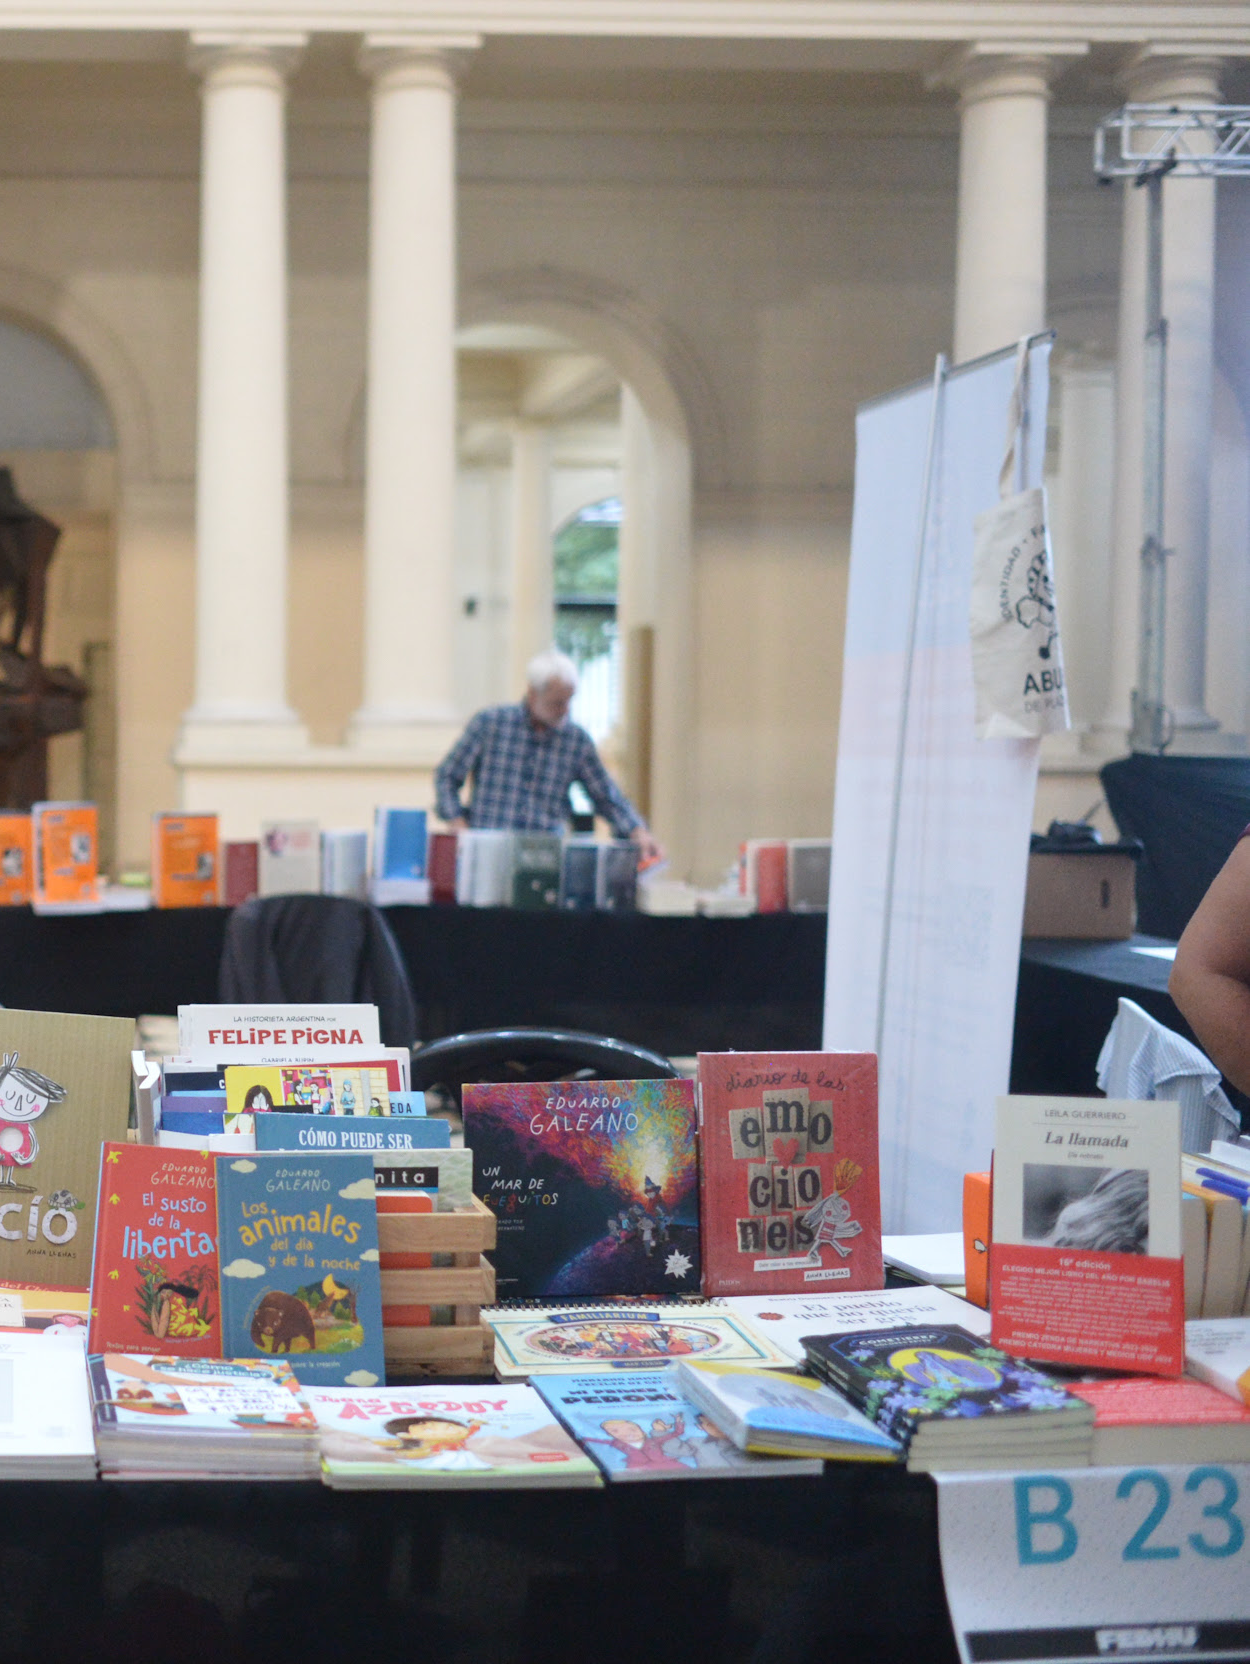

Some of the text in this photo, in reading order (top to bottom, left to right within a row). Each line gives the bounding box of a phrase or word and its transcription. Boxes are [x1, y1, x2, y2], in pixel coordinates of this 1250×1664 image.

[726, 1069, 845, 1092] diario de las
[545, 1096, 621, 1110] EDUARDO
[1045, 1109, 1126, 1120] LEILA GUERRIERO
[530, 1112, 639, 1135] GALEANO
[740, 1099, 833, 1149] emo
[299, 1127, 413, 1150] CÓMO PUEDE SER
[1044, 1131, 1129, 1149] La llamada
[162, 1163, 207, 1174] EDUARDO
[275, 1169, 320, 1178] EDUARDO
[482, 1166, 501, 1176] UN
[151, 1173, 215, 1189] GALEANO
[265, 1178, 331, 1192] GALEANO
[491, 1178, 545, 1190] MAR DE
[750, 1168, 821, 1209] cio
[142, 1192, 207, 1213] El susto
[241, 1201, 267, 1218] Los
[148, 1213, 180, 1230] de la
[238, 1204, 361, 1246] animales
[738, 1216, 815, 1252] nes
[122, 1226, 218, 1259] liberta
[270, 1237, 314, 1251] del día
[27, 1248, 77, 1258] ANNA LLENAS
[268, 1252, 361, 1271] y de la noche
[1075, 1260, 1111, 1270] edición
[1035, 1267, 1060, 1275] MEJOR
[1101, 1273, 1118, 1281] AÑO
[0, 1281, 22, 1289] del
[793, 1312, 831, 1321] que
[869, 1305, 937, 1317] quería
[832, 1301, 903, 1312] pueblo
[560, 1312, 648, 1322] FAMILIARIUM
[836, 1314, 918, 1325] ser gris
[858, 1335, 937, 1346] COMETIERRA
[999, 1338, 1027, 1347] PREMIO
[1012, 1331, 1040, 1340] PREMIO
[178, 1366, 210, 1374] hace
[213, 1369, 273, 1379] justicia?
[560, 1393, 677, 1404] PERONI
[1013, 1465, 1245, 1565] B 23
